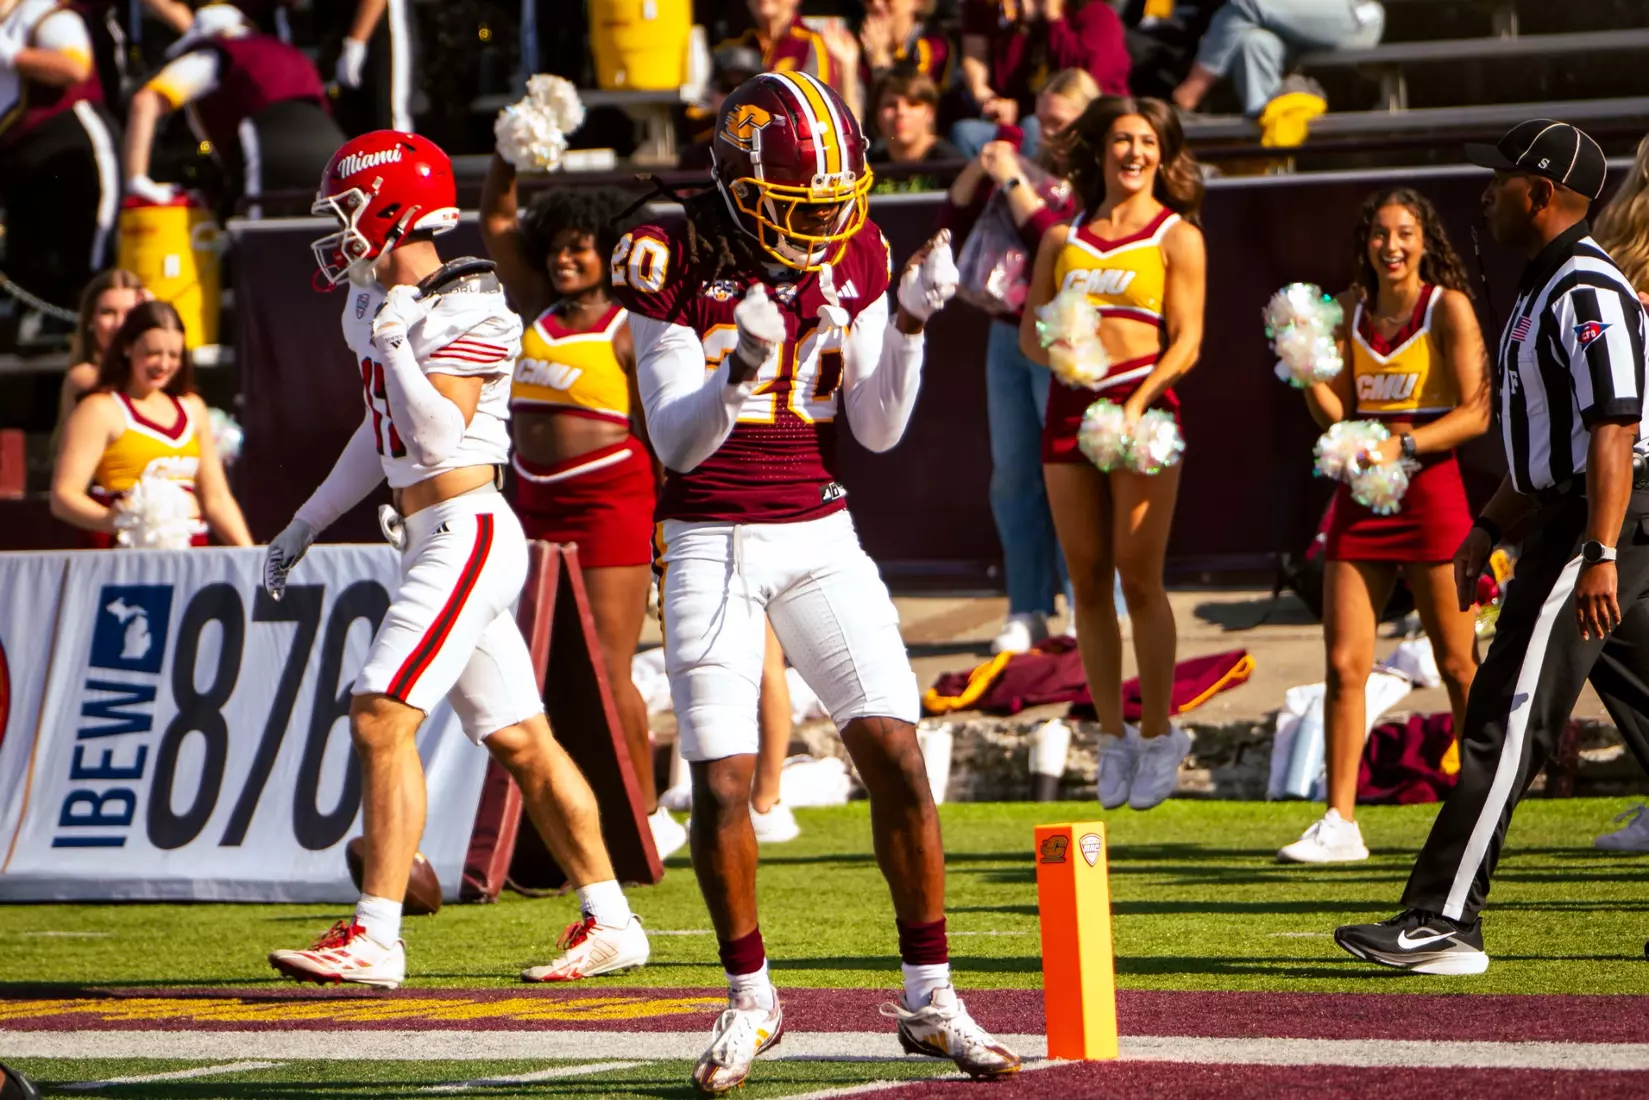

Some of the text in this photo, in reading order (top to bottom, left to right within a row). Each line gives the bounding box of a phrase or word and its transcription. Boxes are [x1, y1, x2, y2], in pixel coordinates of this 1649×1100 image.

[338, 143, 401, 178] Miami
[1537, 158, 1550, 169] S
[611, 233, 670, 293] 20
[1061, 268, 1137, 295] CMU
[515, 357, 583, 391] CMU
[1356, 373, 1419, 400] CMU
[146, 579, 391, 851] 876
[51, 677, 158, 849] IBEW
